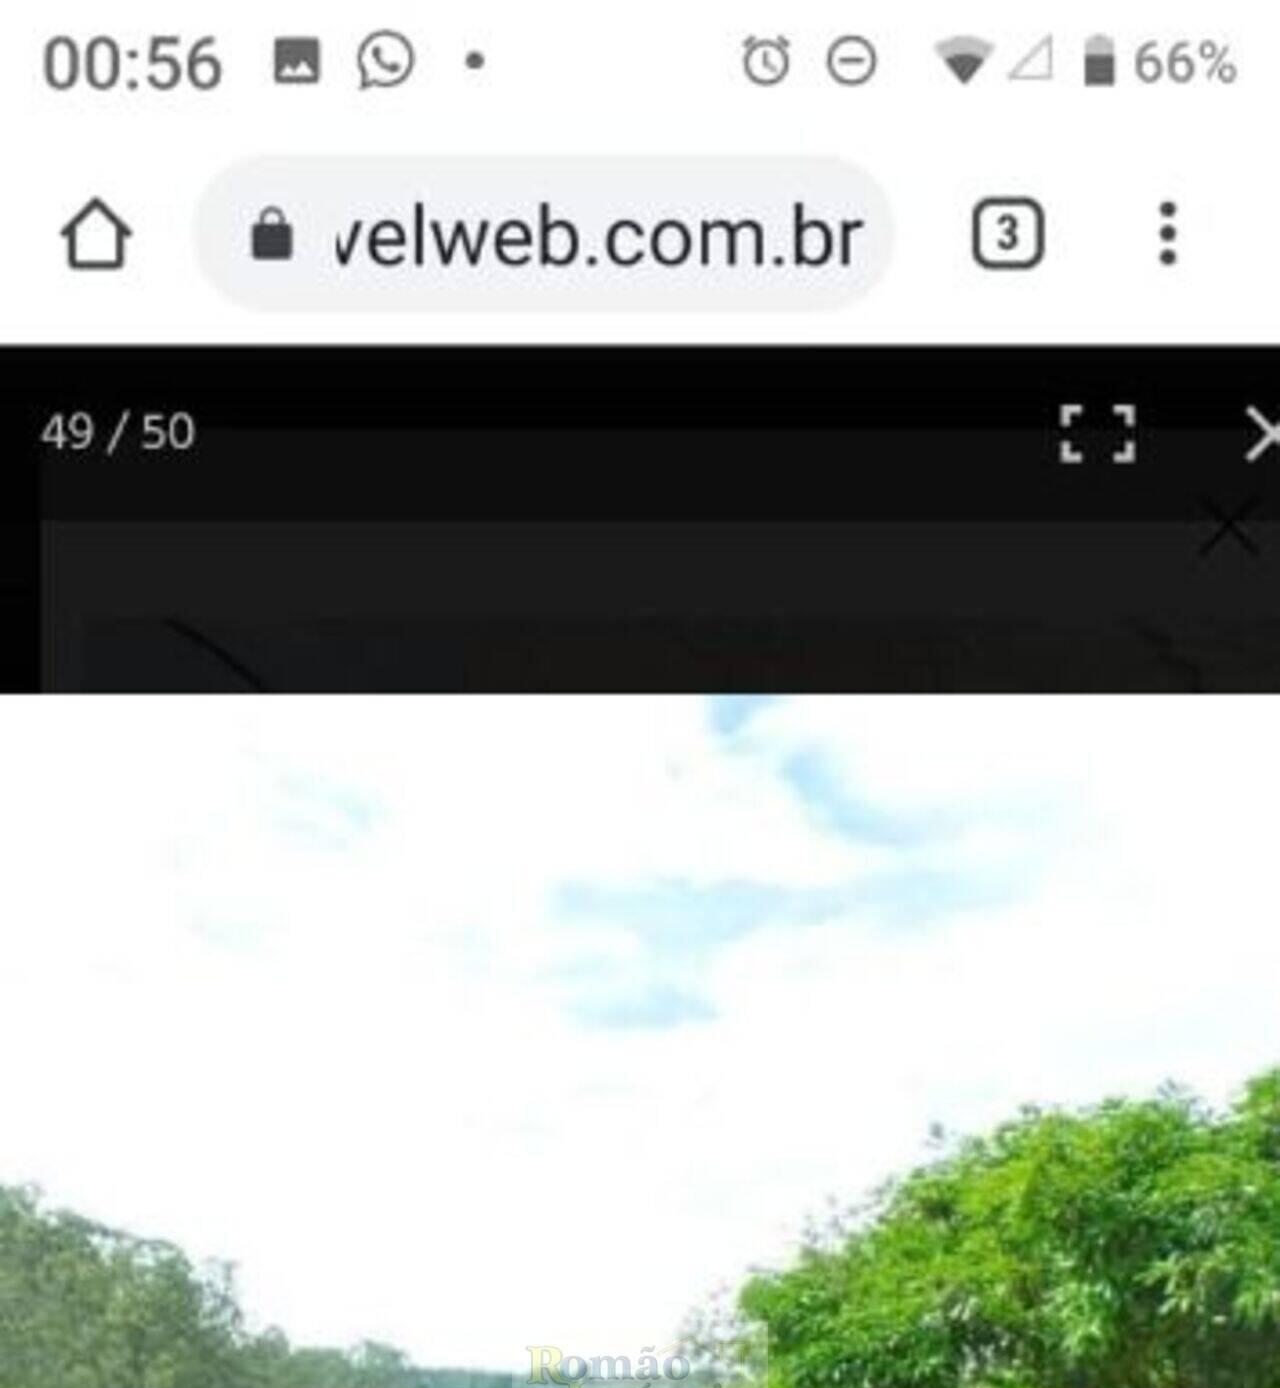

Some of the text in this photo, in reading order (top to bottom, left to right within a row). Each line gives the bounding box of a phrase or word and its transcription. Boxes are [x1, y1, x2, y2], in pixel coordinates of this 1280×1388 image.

[43, 36, 222, 92] 00:56
[1134, 40, 1238, 84] 66%
[335, 202, 865, 268] velweb.com.br
[996, 216, 1018, 251] 3
[41, 412, 94, 450] 49
[142, 412, 195, 450] 50
